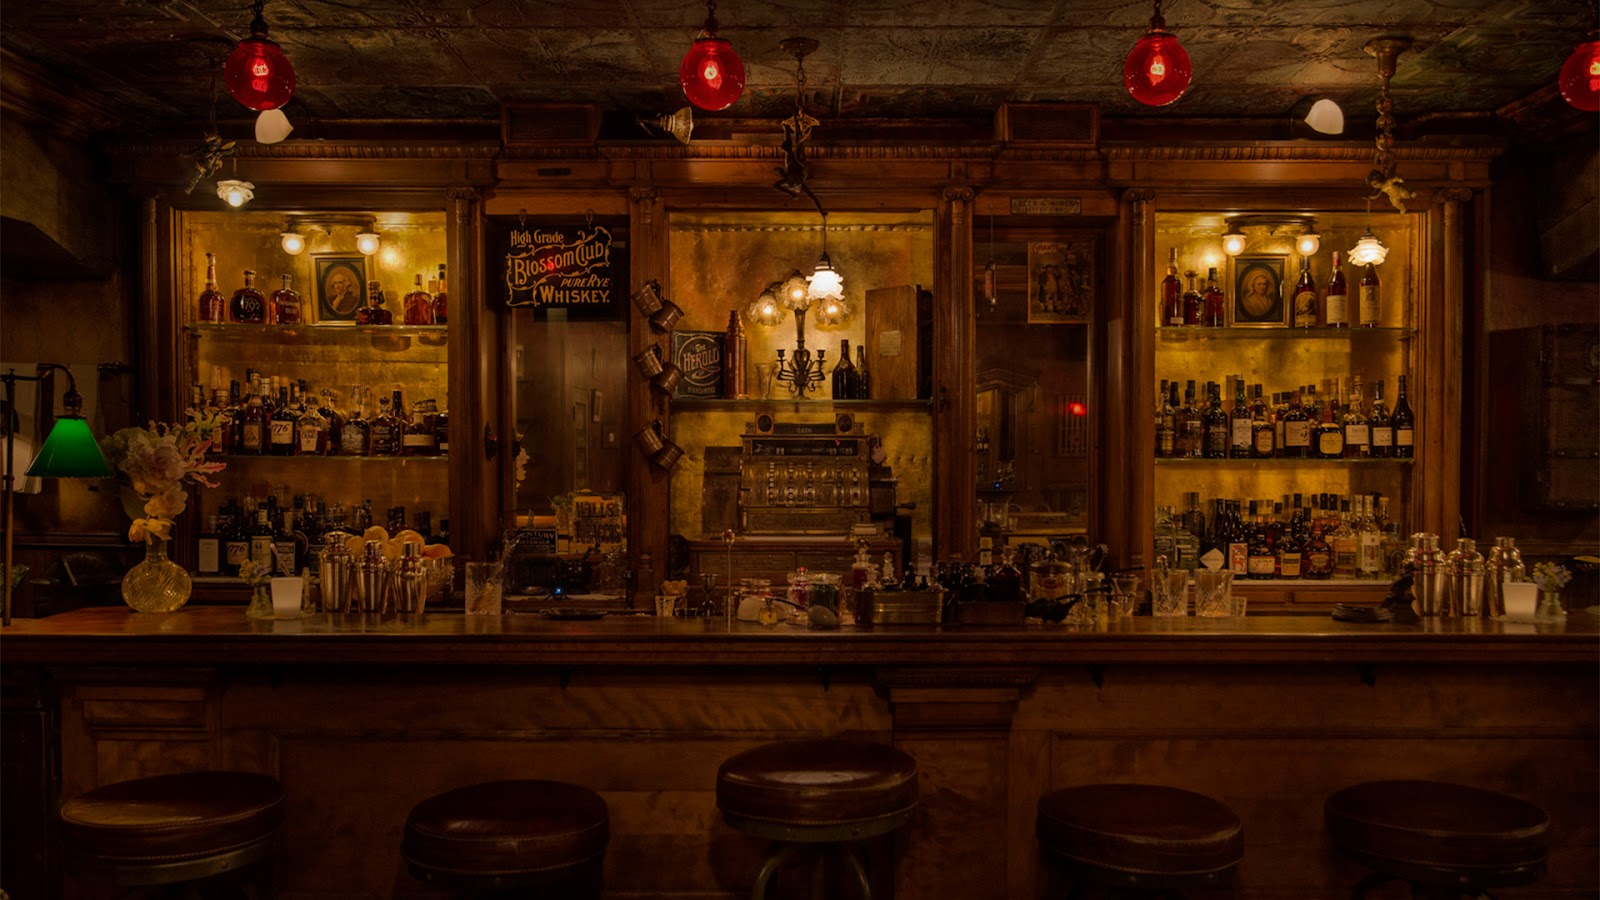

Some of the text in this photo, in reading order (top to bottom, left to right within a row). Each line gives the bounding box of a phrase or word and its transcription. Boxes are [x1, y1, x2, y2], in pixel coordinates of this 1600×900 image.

[510, 229, 564, 248] High Grade
[575, 240, 604, 267] Club
[560, 274, 610, 288] PURE RYE
